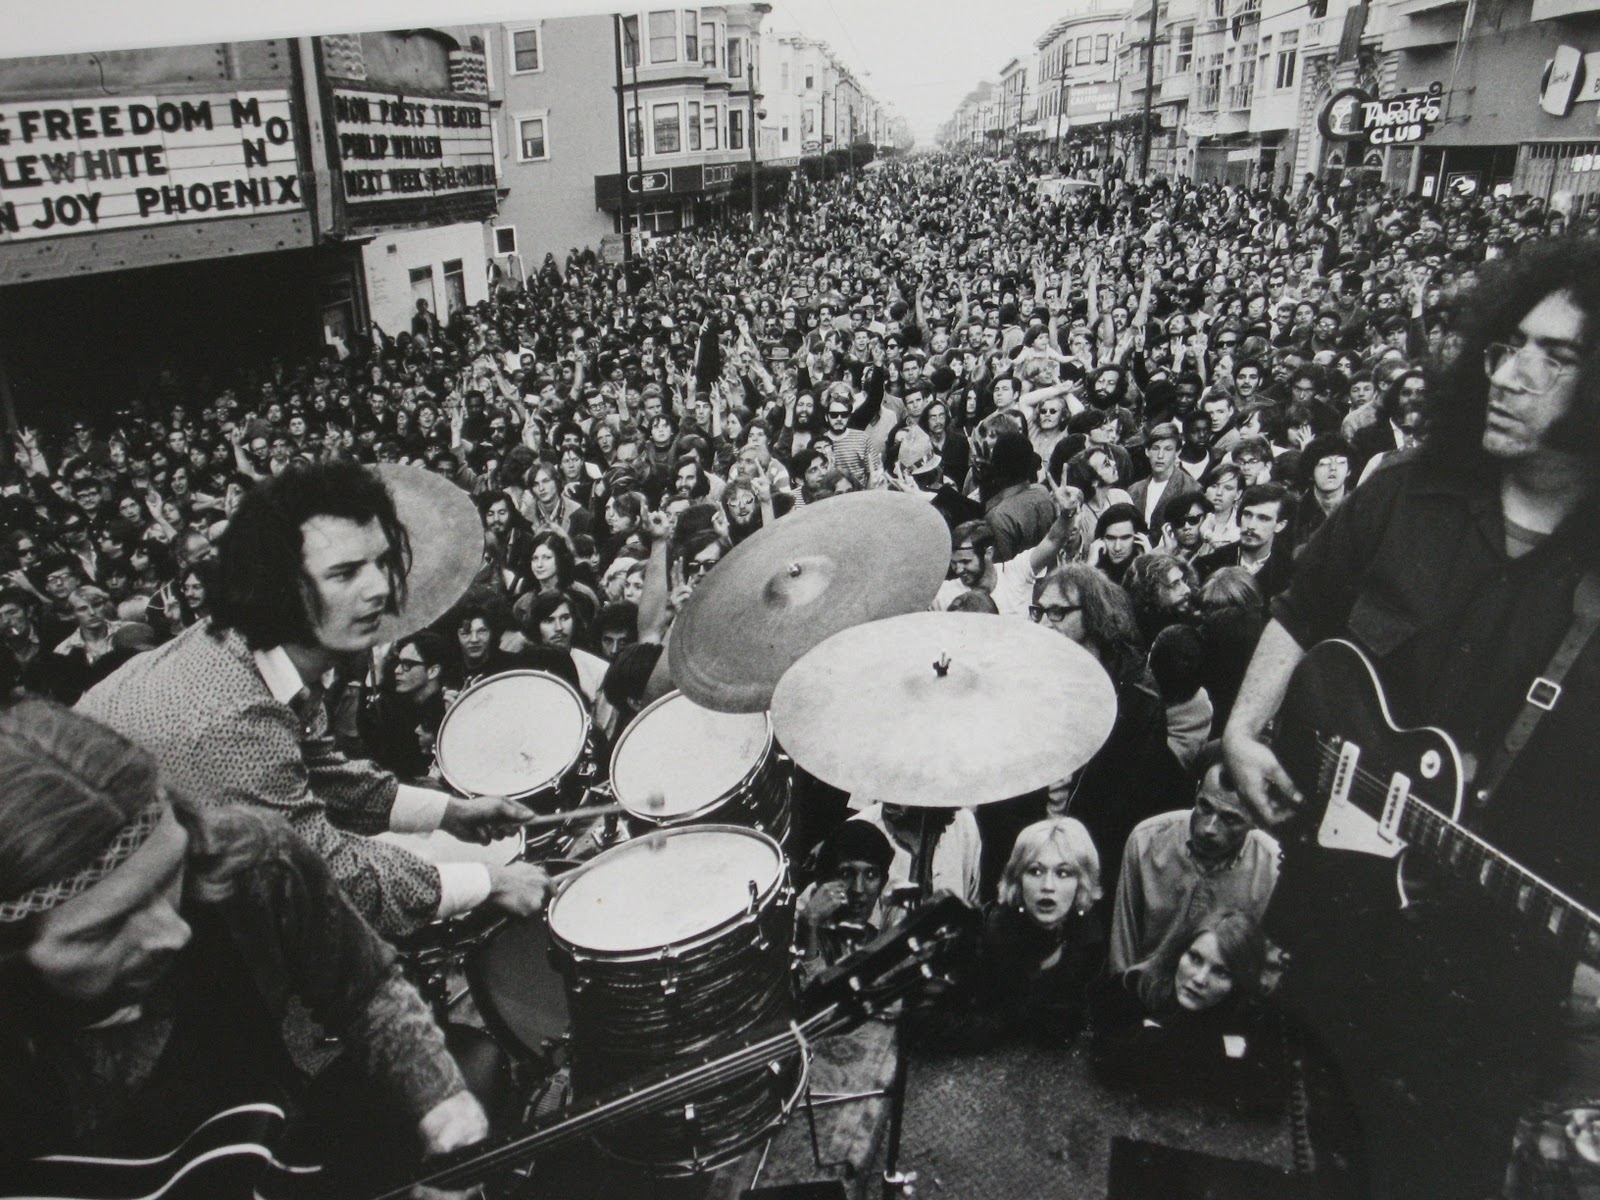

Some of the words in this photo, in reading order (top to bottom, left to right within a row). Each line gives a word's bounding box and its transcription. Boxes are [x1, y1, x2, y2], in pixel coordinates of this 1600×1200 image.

[18, 101, 214, 143] FREEDOM
[1370, 124, 1422, 145] CLUB
[344, 169, 383, 197] NEXT
[32, 192, 102, 229] JOY
[136, 174, 301, 218] PHOENIX
